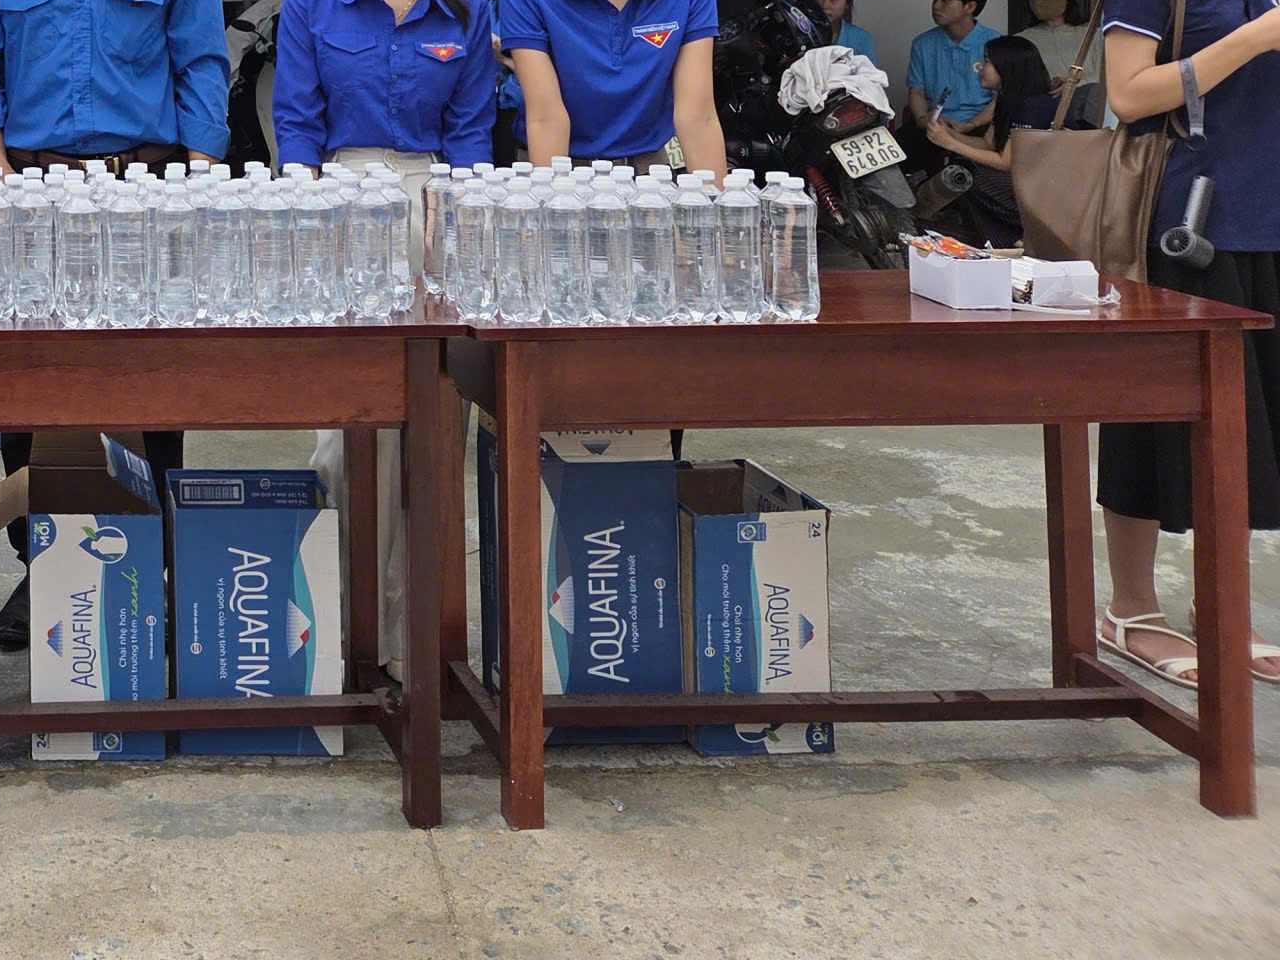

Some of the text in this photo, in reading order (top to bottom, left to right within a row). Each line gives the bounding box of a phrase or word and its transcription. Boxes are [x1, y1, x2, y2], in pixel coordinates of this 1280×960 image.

[812, 522, 821, 538] 24
[628, 554, 636, 575] khiết
[722, 564, 730, 581] Cho
[216, 577, 224, 586] vị
[722, 583, 730, 598] môi
[216, 588, 224, 609] ngon
[583, 526, 630, 682] AQUAFINA
[631, 594, 638, 604] sự
[218, 611, 226, 626] của
[228, 547, 274, 698] AQUAFINA
[628, 606, 638, 620] của
[721, 600, 730, 628] trường
[734, 605, 742, 624] Chai
[118, 608, 128, 668] Chai nhẹ hơn
[120, 566, 140, 691] môi trường thêm xanh
[218, 628, 224, 638] sự
[734, 627, 742, 644] nhẹ
[764, 583, 792, 681] AQUAFINA
[70, 589, 97, 688] AQUAFINA
[723, 630, 731, 652] thêm
[631, 645, 640, 653] vị
[218, 658, 228, 680] khiết
[36, 732, 46, 748] 24
